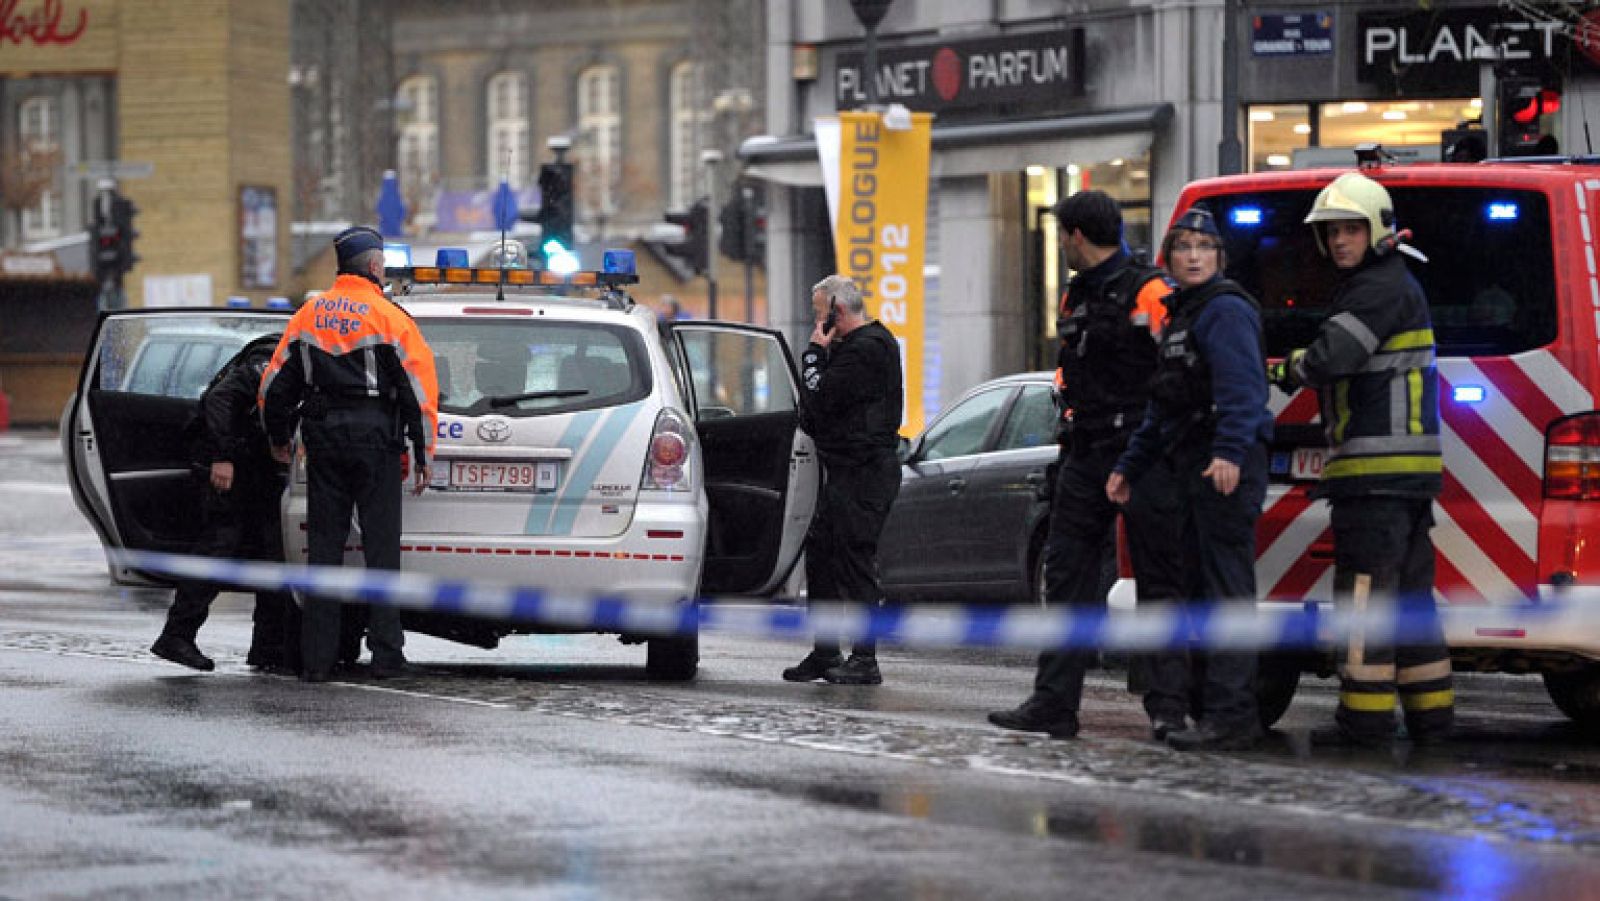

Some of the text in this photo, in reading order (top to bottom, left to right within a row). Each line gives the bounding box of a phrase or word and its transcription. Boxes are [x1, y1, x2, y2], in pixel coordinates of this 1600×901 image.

[968, 46, 1068, 90] PARFUM
[849, 118, 880, 320] ROLOGUE
[315, 296, 370, 315] Police
[880, 224, 909, 325] 2012
